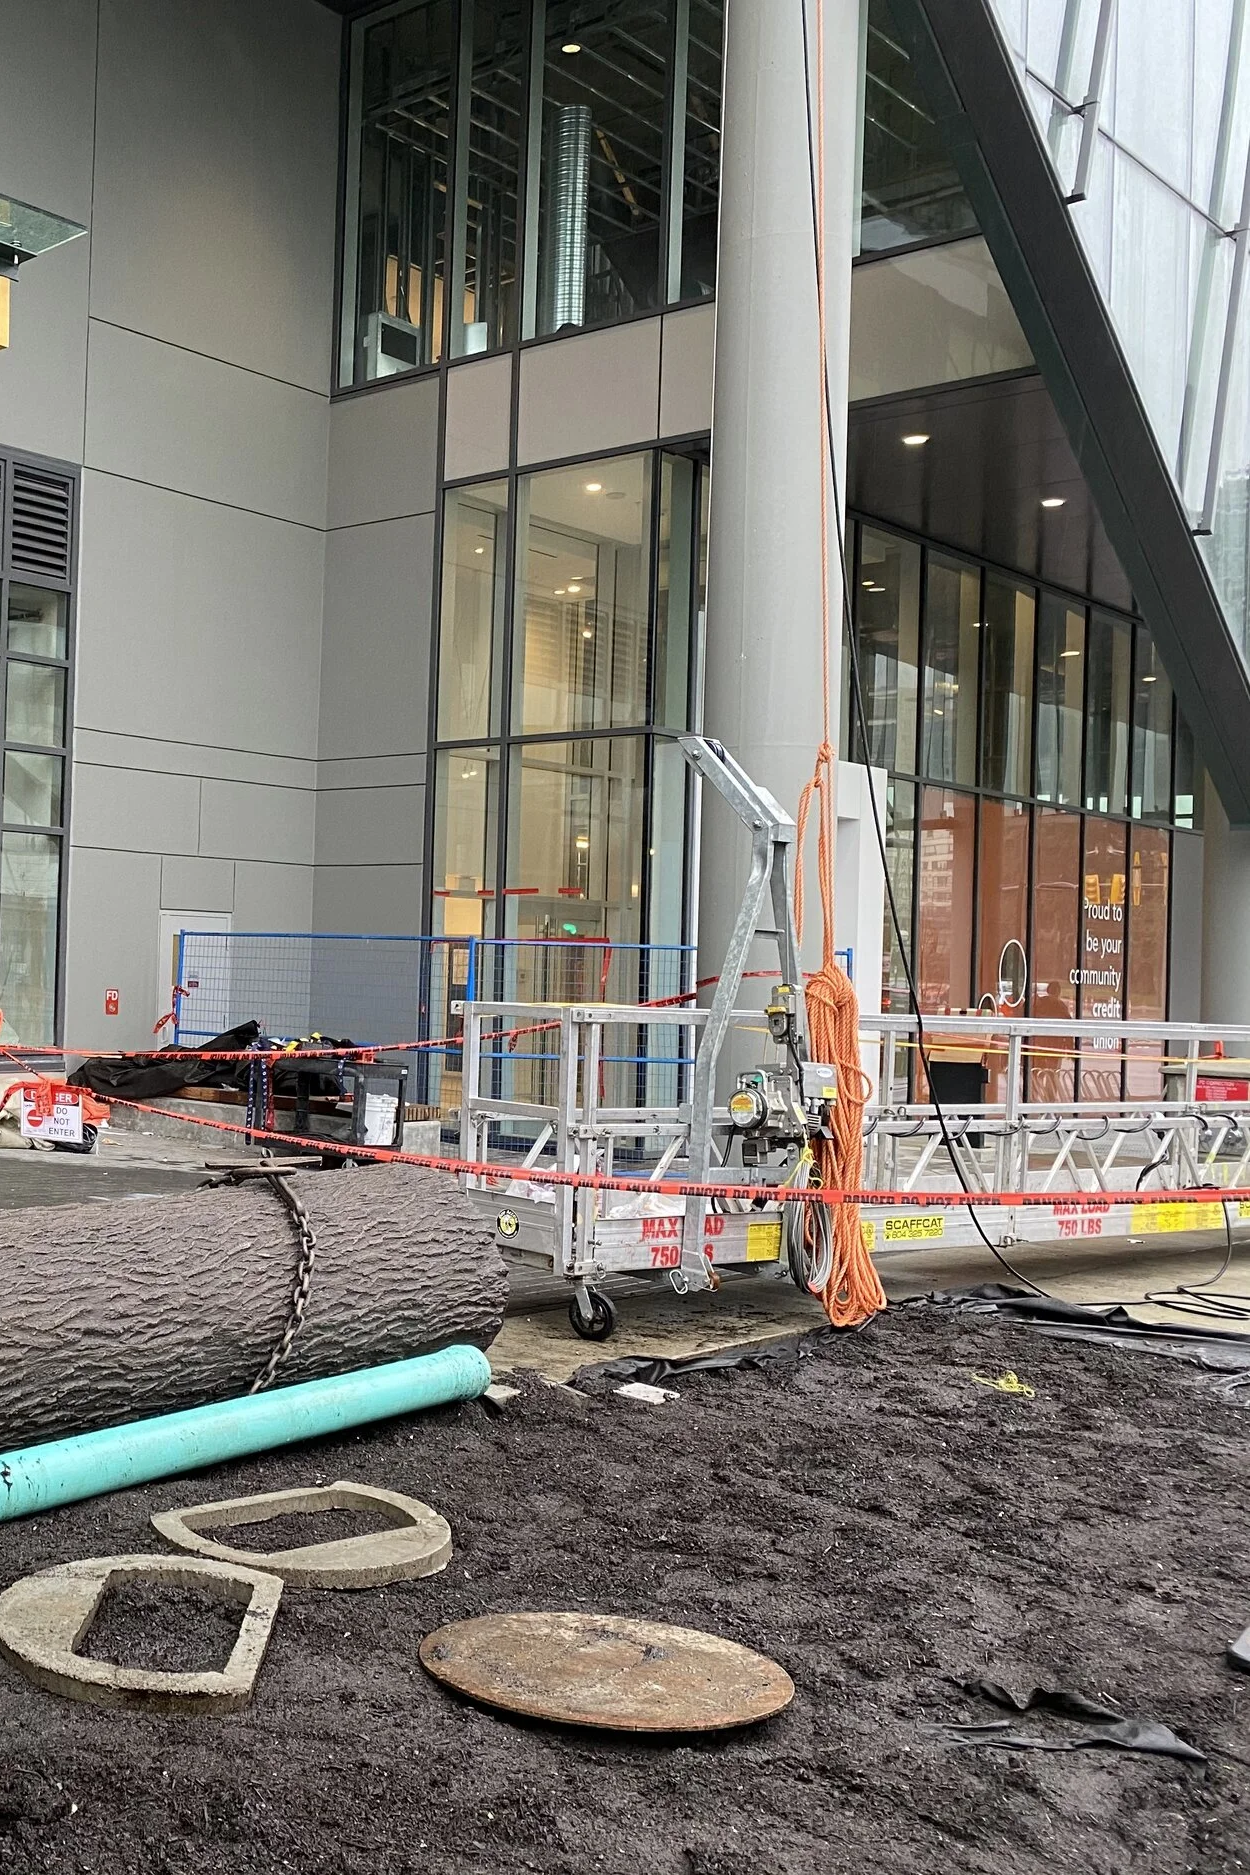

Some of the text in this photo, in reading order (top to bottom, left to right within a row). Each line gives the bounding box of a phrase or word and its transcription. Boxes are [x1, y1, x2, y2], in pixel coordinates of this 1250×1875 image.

[1112, 904, 1123, 922] to
[1086, 929, 1122, 958] be your
[106, 990, 118, 1001] FD
[1092, 996, 1121, 1018] credit
[1093, 1036, 1119, 1050] union
[30, 1090, 73, 1103] DGER
[56, 1106, 68, 1115] DO
[53, 1117, 70, 1125] NOT
[48, 1127, 75, 1137] ENTER
[679, 1186, 727, 1198] DANGER
[732, 1189, 750, 1199] DO
[755, 1190, 781, 1200] NOT
[641, 1216, 726, 1239] MAX AD
[885, 1217, 944, 1230] SCAFFCAT
[1057, 1218, 1102, 1237] 750 LBS
[908, 1230, 923, 1238] 325
[924, 1228, 944, 1237] 7220
[651, 1245, 679, 1268] 750
